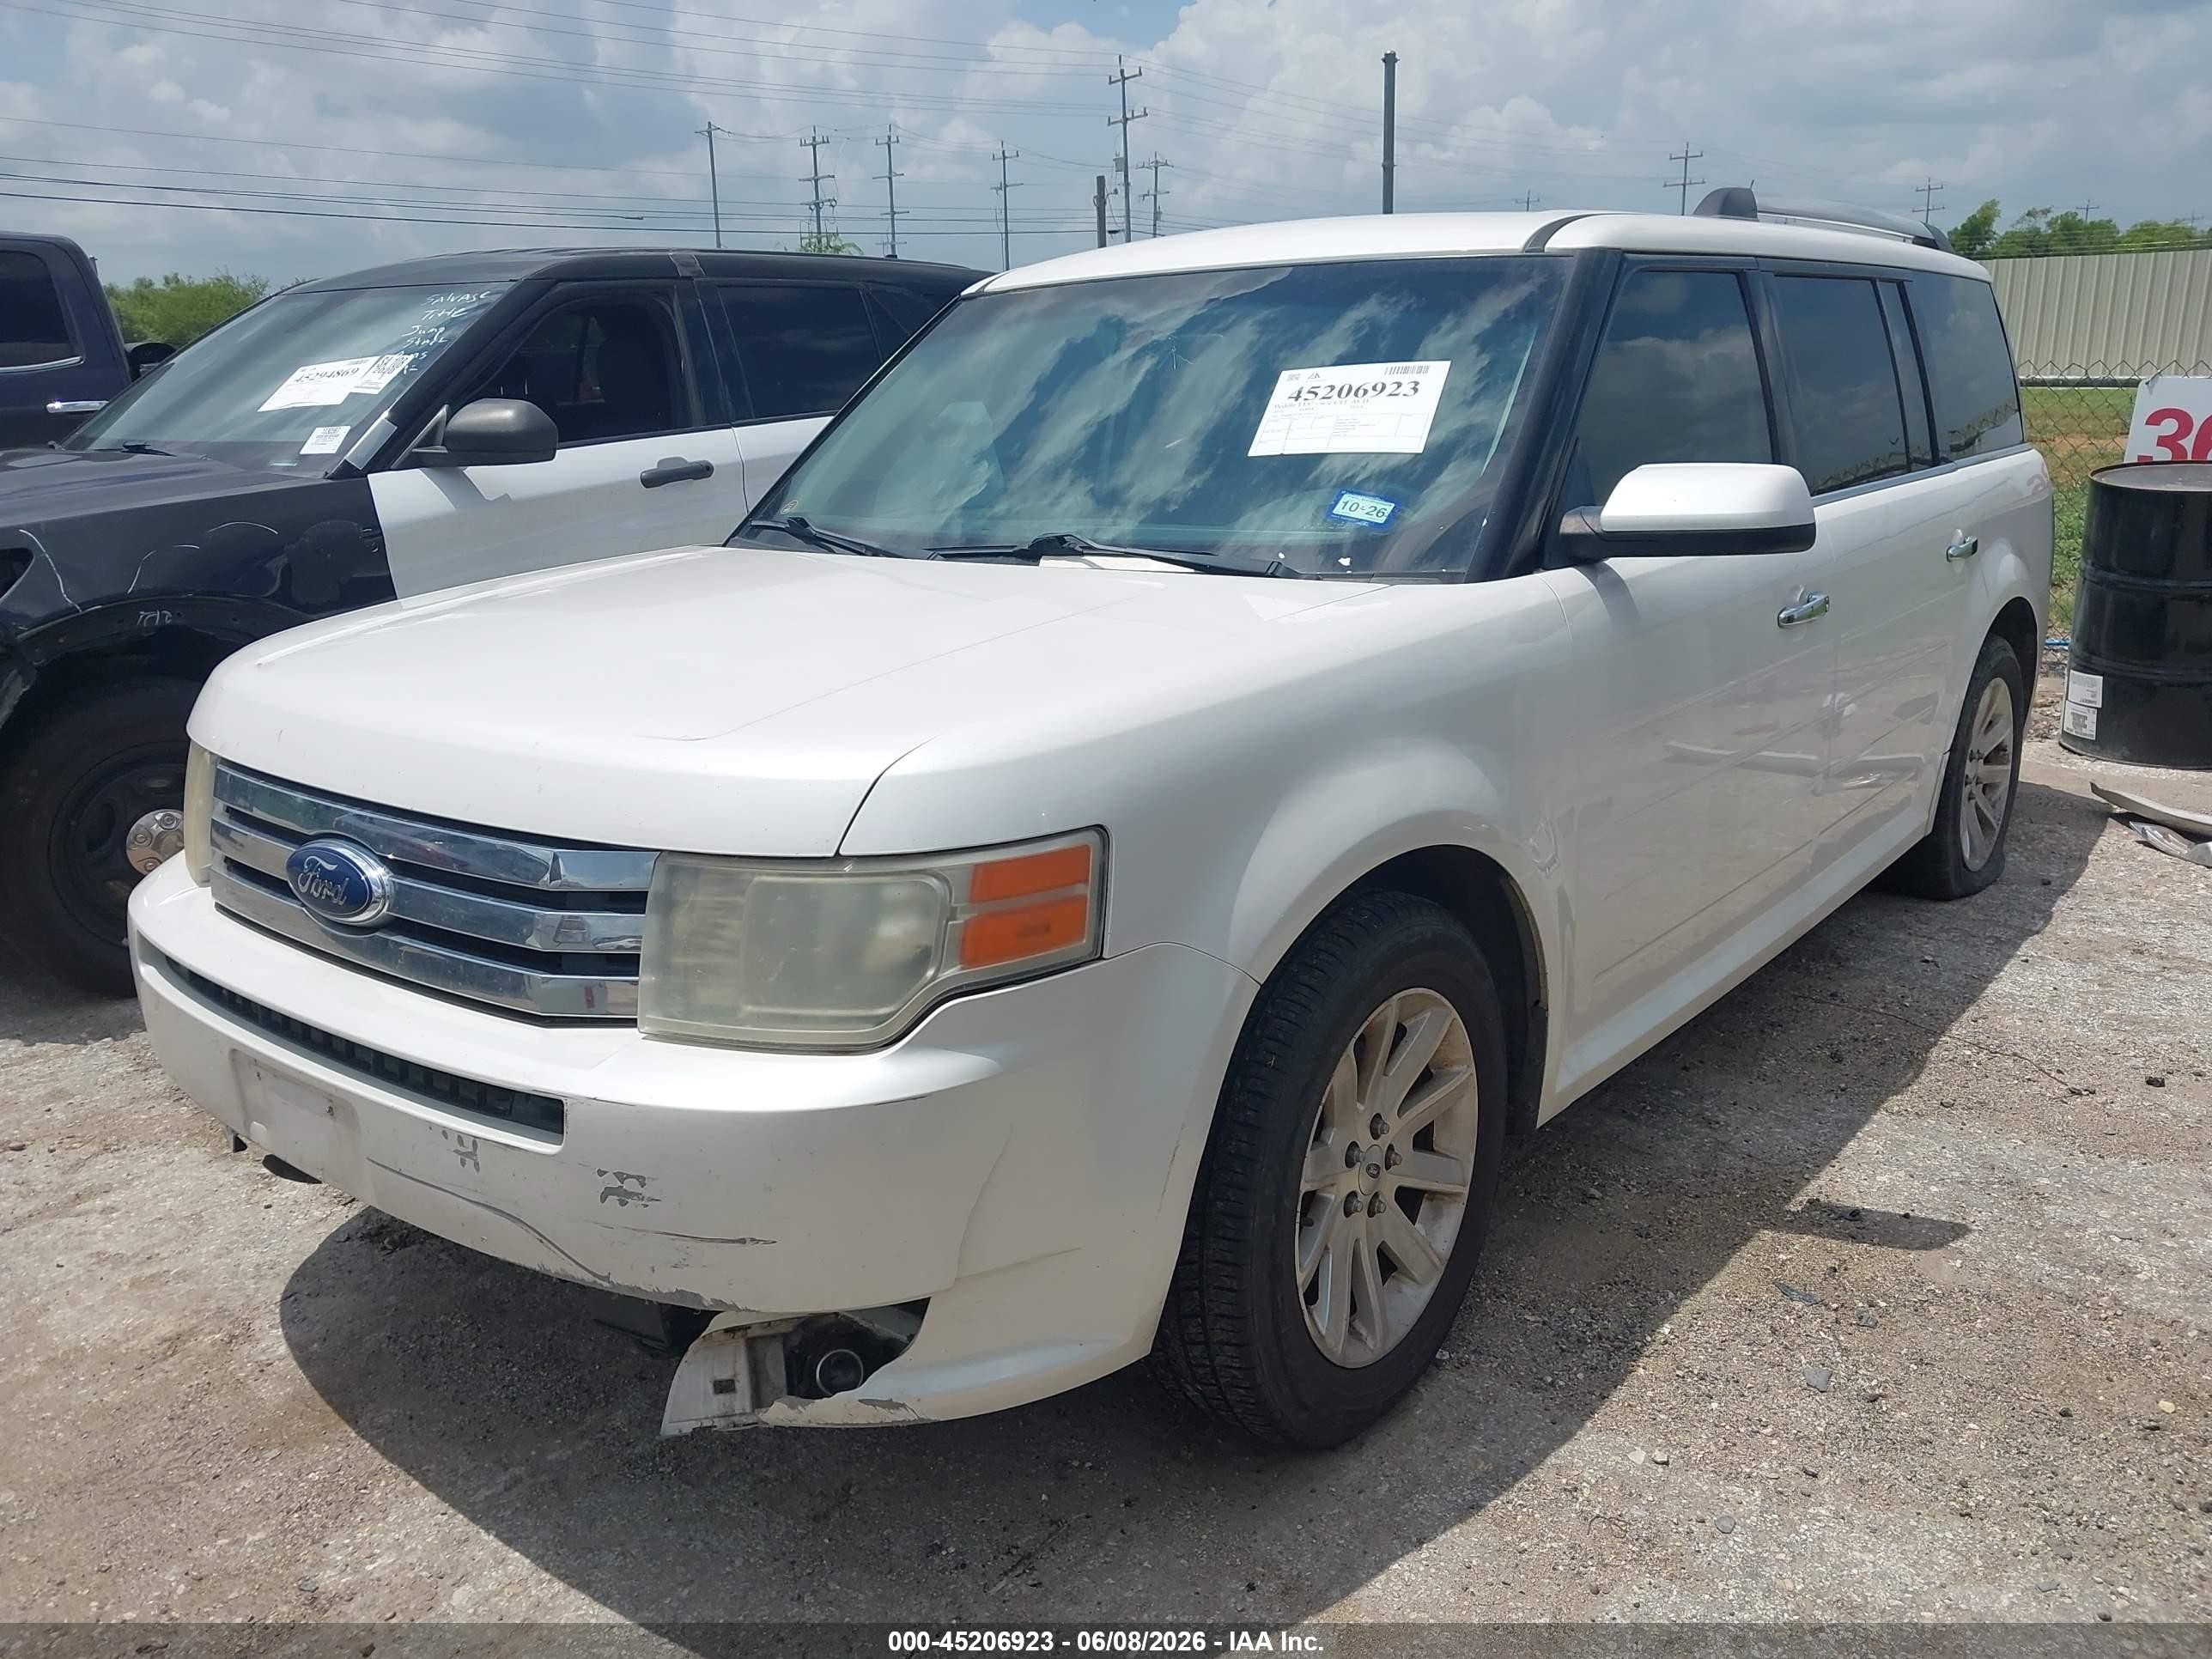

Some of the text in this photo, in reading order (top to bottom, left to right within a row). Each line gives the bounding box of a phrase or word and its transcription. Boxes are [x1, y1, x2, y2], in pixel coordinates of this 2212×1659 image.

[1288, 380, 1421, 402] 45206923
[2136, 407, 2212, 461] 3
[297, 855, 349, 905] Ford
